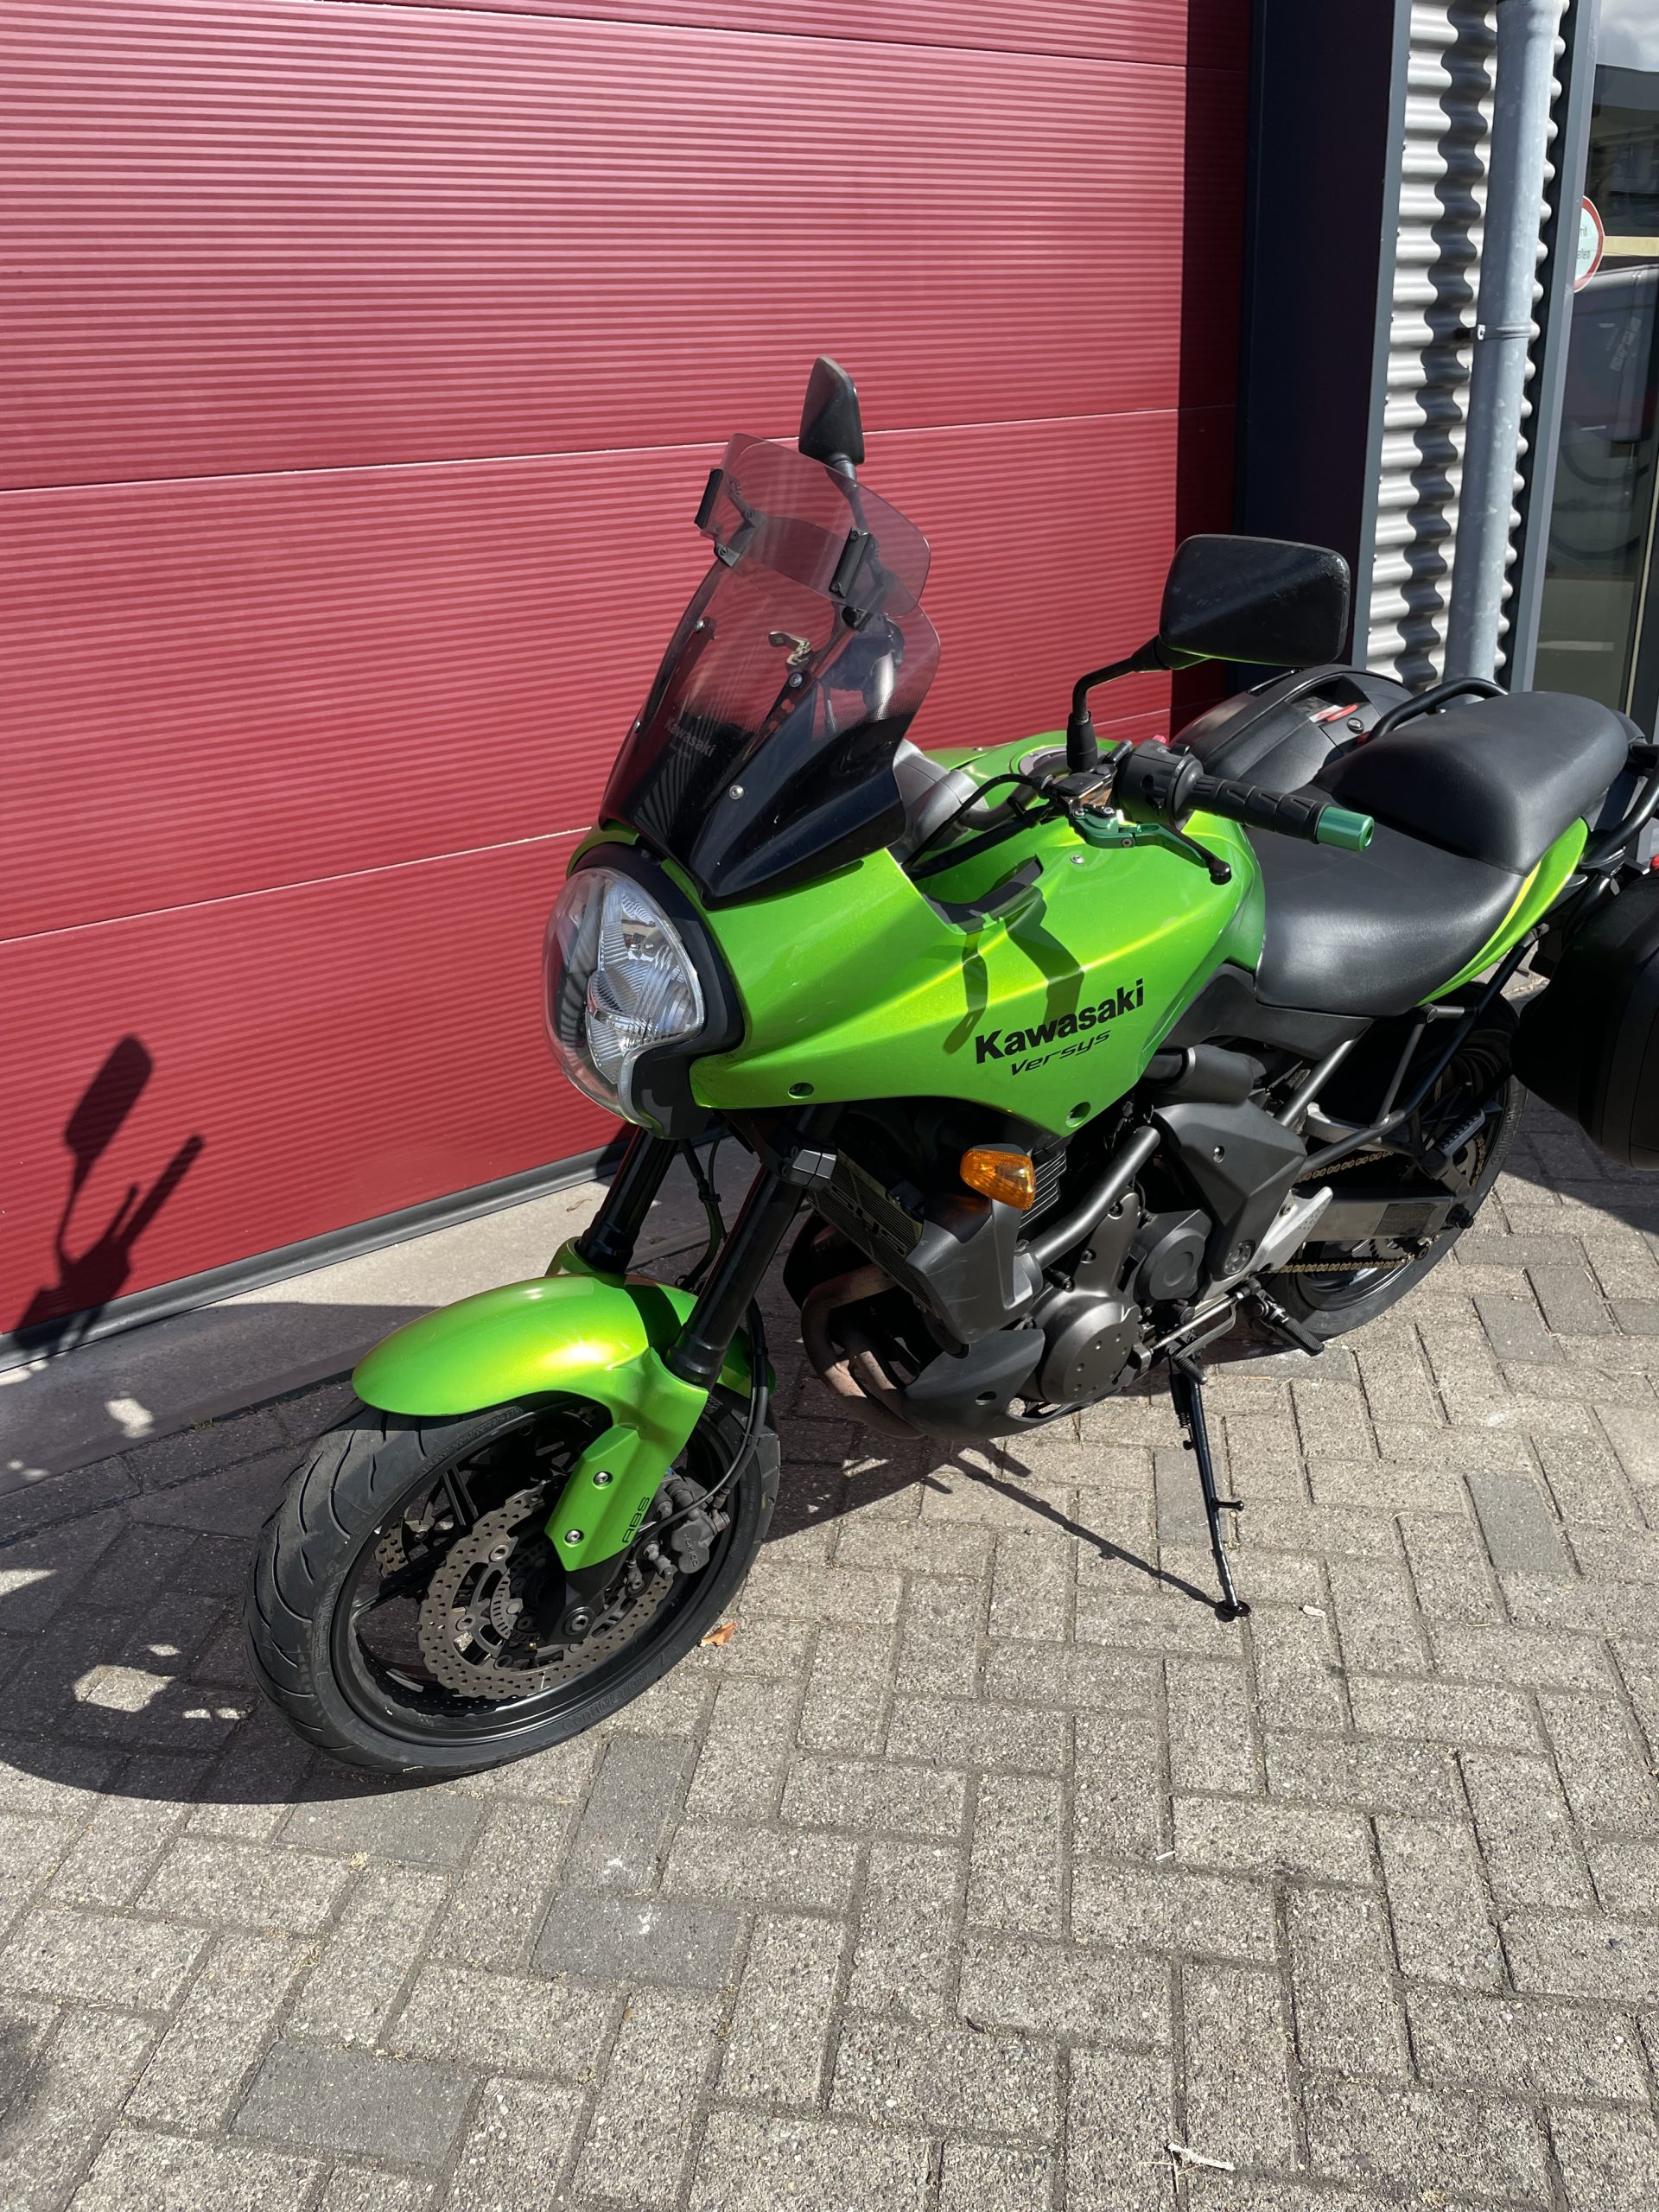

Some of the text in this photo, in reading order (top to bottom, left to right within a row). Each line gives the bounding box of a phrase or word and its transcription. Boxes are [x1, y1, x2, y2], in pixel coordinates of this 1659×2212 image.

[664, 716, 717, 758] Kawasaki
[975, 977, 1144, 1065] Kawasaki
[621, 1496, 650, 1543] ABS
